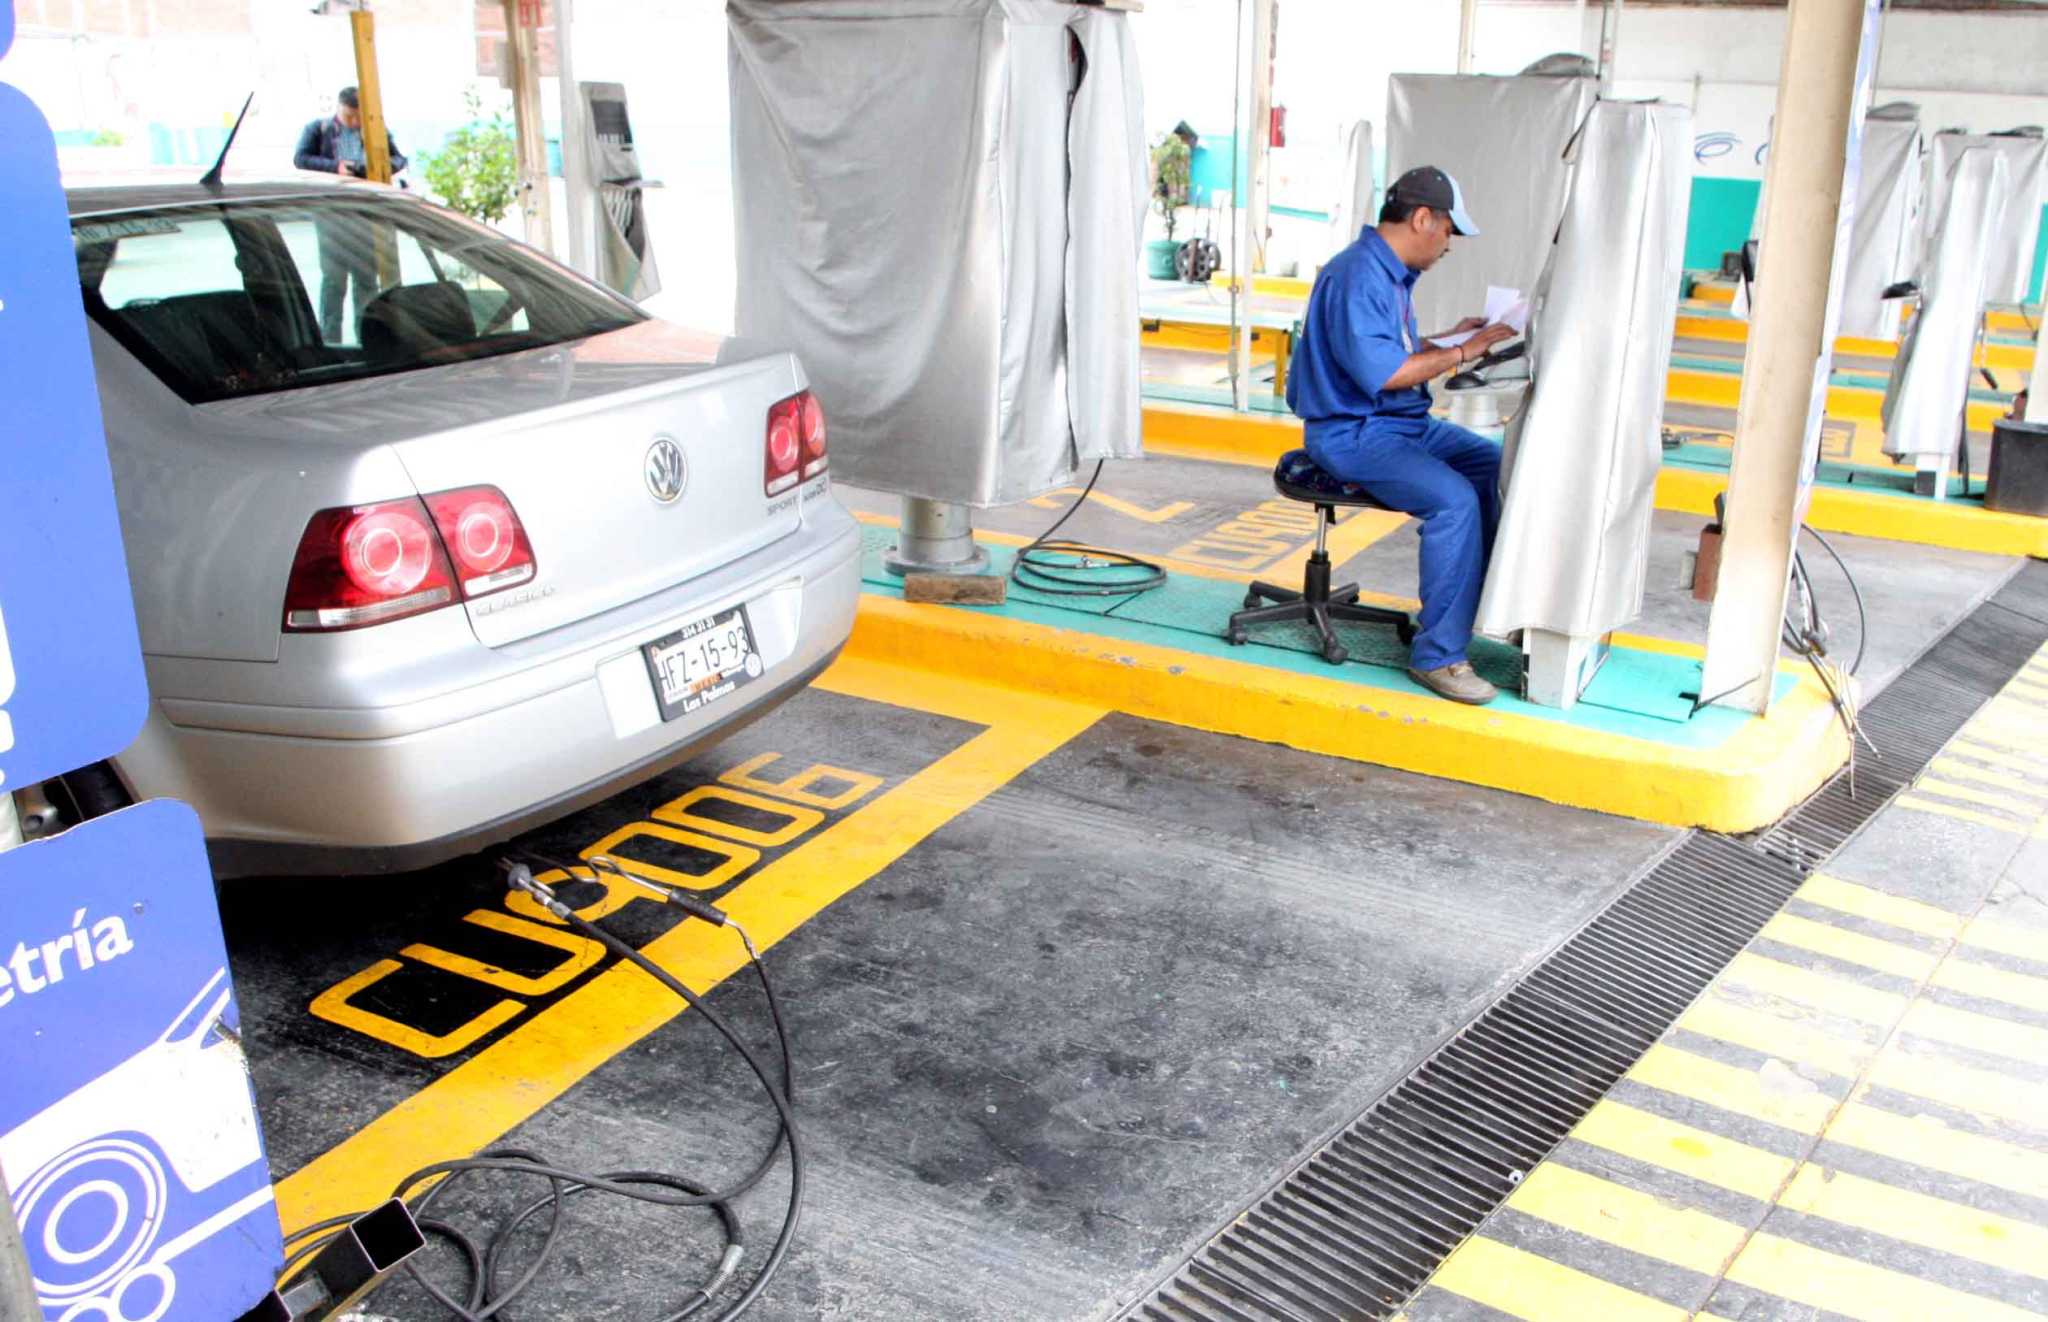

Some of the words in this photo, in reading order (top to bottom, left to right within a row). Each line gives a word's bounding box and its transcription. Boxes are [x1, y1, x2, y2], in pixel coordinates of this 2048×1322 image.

[683, 696, 702, 713] Las
[701, 680, 736, 705] Palmas
[308, 752, 884, 1058] CU9006
